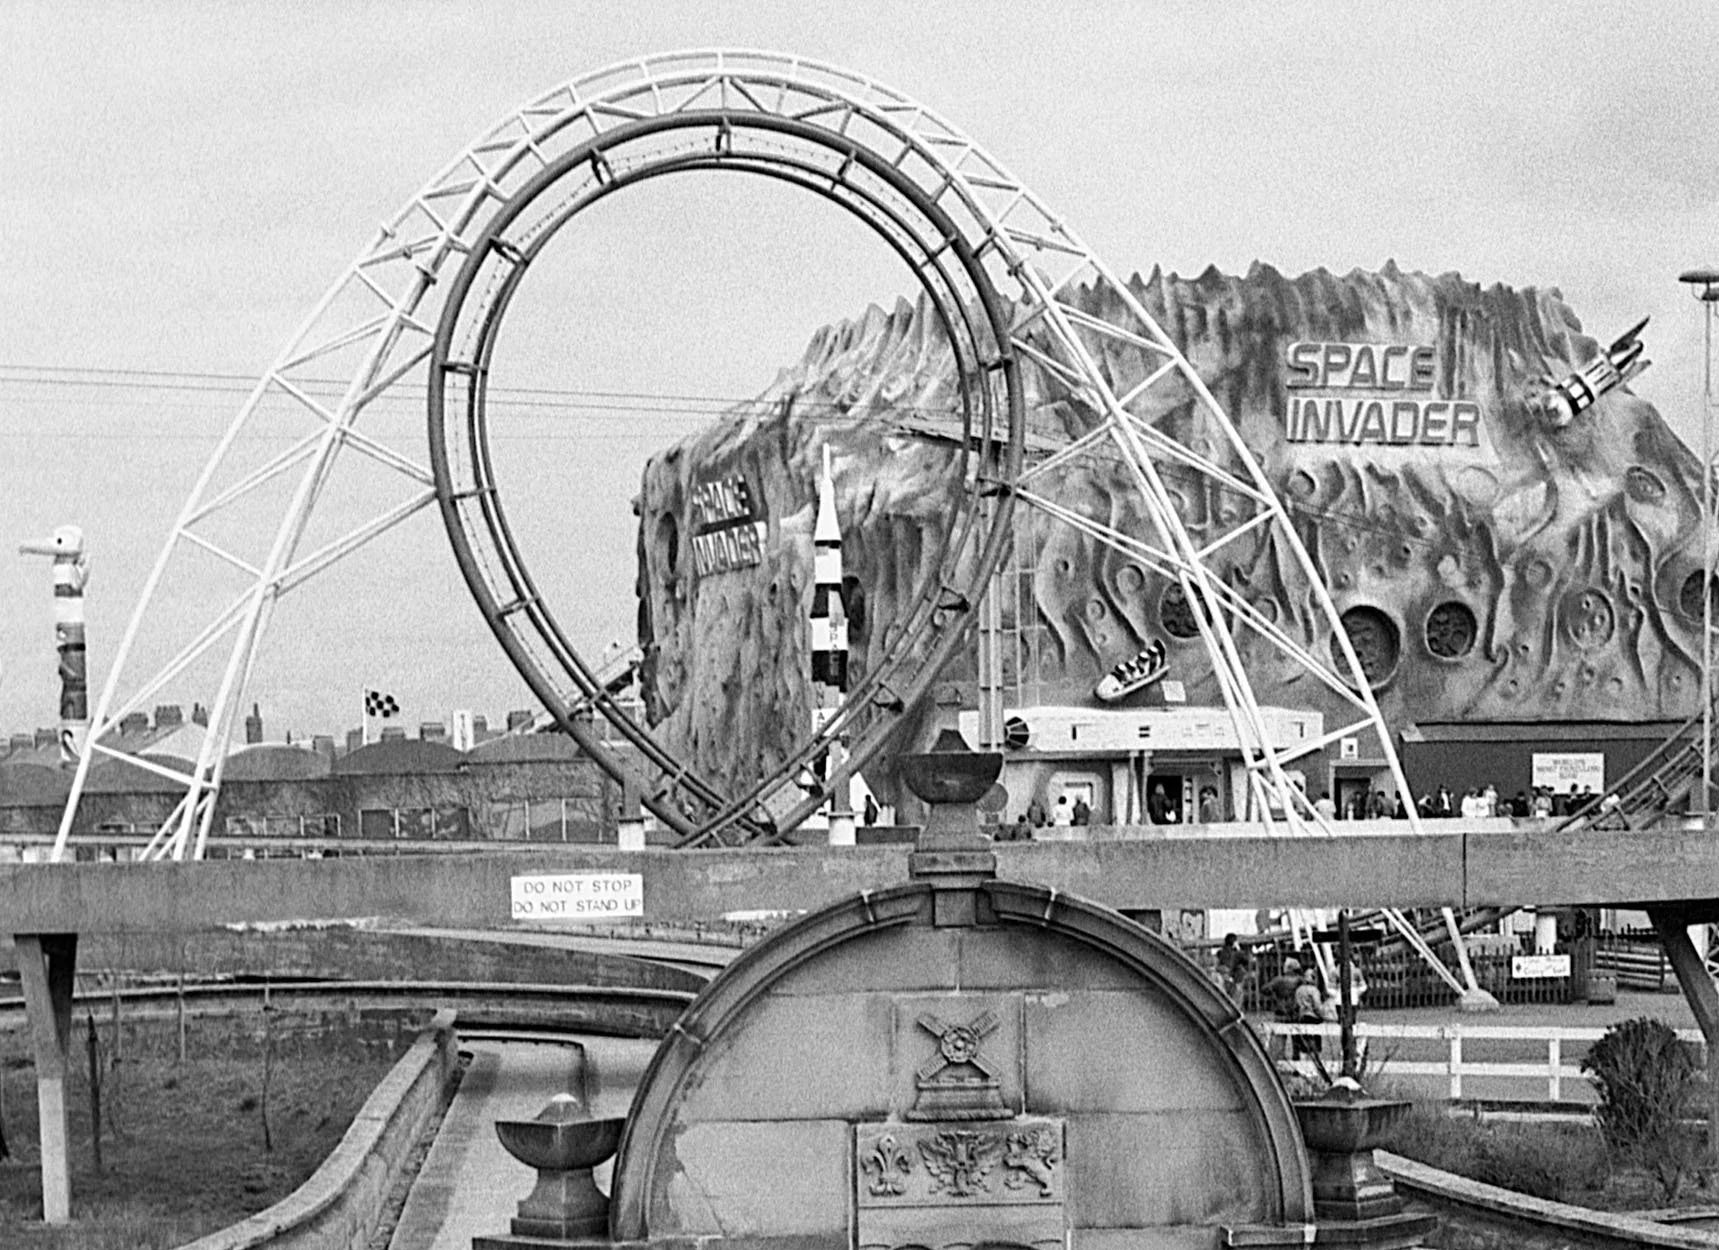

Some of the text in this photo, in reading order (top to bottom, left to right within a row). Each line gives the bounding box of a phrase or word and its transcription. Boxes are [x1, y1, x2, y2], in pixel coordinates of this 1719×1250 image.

[1287, 342, 1436, 390] SPACE
[1287, 397, 1480, 446] INVADER
[524, 880, 632, 894] DO NOT STOP
[514, 899, 641, 913] DO NOT STAND UP
